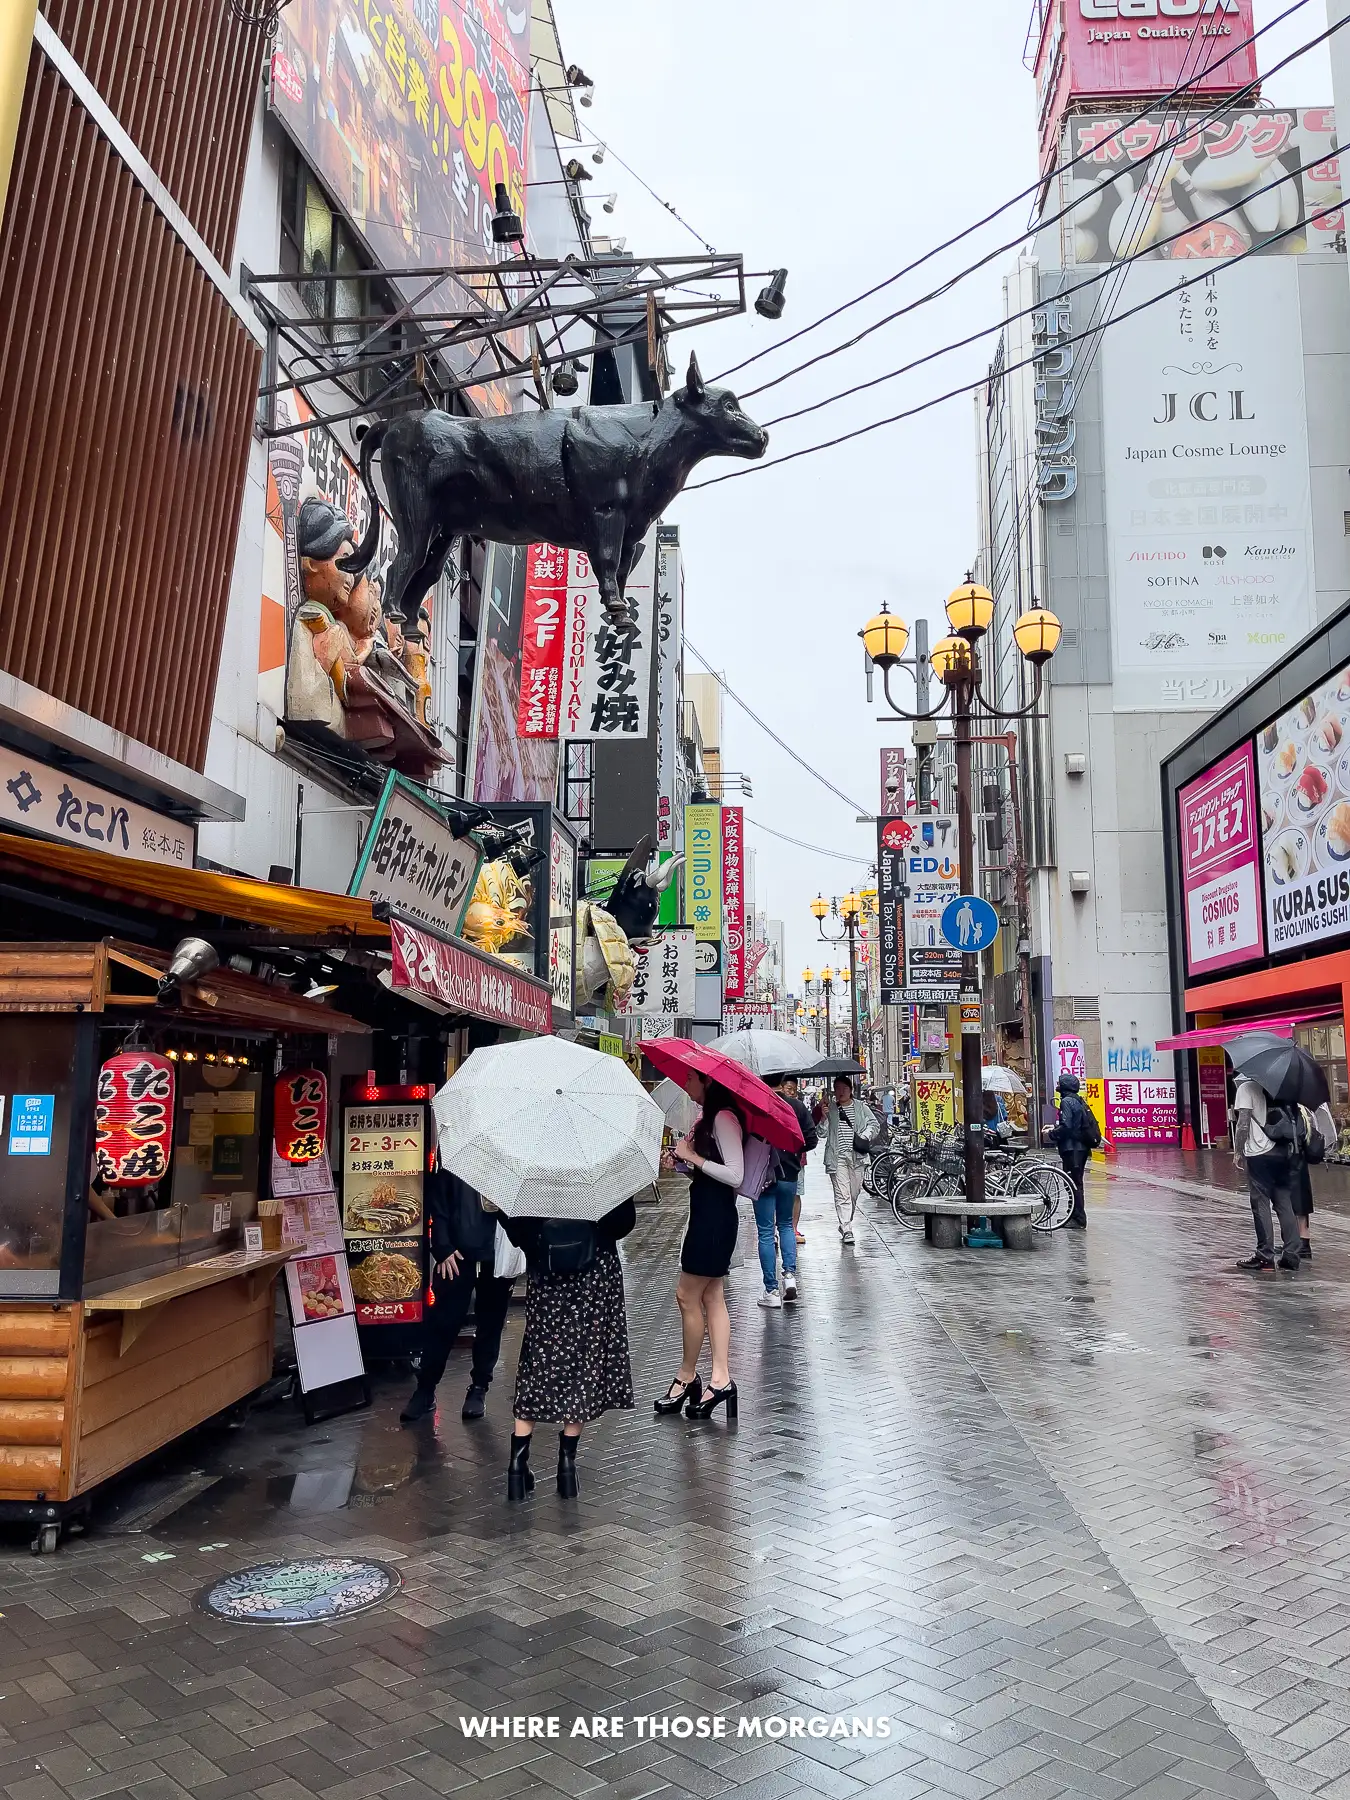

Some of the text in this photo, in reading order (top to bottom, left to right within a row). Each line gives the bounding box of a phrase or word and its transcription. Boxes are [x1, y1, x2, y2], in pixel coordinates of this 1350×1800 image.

[1088, 24, 1232, 44] Japan Quality Life
[1077, 113, 1293, 164] ボウリング
[1178, 274, 1194, 344] あなたに。
[1204, 275, 1220, 350] 日本の美を
[1032, 296, 1078, 501] ボウリング
[1153, 390, 1256, 424] JCL
[1125, 442, 1287, 462] Japan Cosme Lounge
[1130, 504, 1289, 527] 日本全国展開中
[1126, 551, 1186, 562] SHISEIDO
[1244, 545, 1296, 556] Kanebo
[1147, 576, 1200, 587] SOFINA
[1143, 598, 1214, 608] KYOTO KOMACHI
[1230, 594, 1280, 607] 上善如水
[533, 597, 560, 648] 2F
[1208, 632, 1227, 643] Spa
[567, 594, 588, 732] OKONOMIYAKI
[525, 667, 550, 733] ぼんくら家
[1161, 675, 1250, 701] 当ビル
[1189, 779, 1243, 827] ディスカウント ドラッグ
[1191, 798, 1244, 860] コスモス
[141, 826, 186, 861] 総本店
[724, 809, 740, 926] 大阪名物実弾禁止
[880, 850, 894, 894] Japan.
[917, 883, 961, 891] 大型家電専門
[1201, 880, 1239, 903] Discount Drugstore
[1272, 868, 1350, 925] KURA SUS
[1202, 892, 1240, 925] COSMOS
[1274, 904, 1349, 944] REVOLVING SUSHI
[883, 899, 897, 986] Tax-free Shop
[661, 943, 680, 1014] お好み焼
[1058, 1040, 1079, 1048] MAX
[1058, 1047, 1085, 1067] 17%
[1114, 1083, 1133, 1102] 薬
[125, 1062, 170, 1180] たこ焼
[289, 1075, 325, 1159] たこ焼
[349, 1112, 420, 1129] お持ち帰り出来ます
[1111, 1106, 1148, 1115] SHISEIDO
[349, 1135, 418, 1152] 2F・3Fへ
[351, 1159, 394, 1171] お好み焼
[372, 1168, 419, 1177] Okonomiyaki
[349, 1238, 385, 1253] 焼そば
